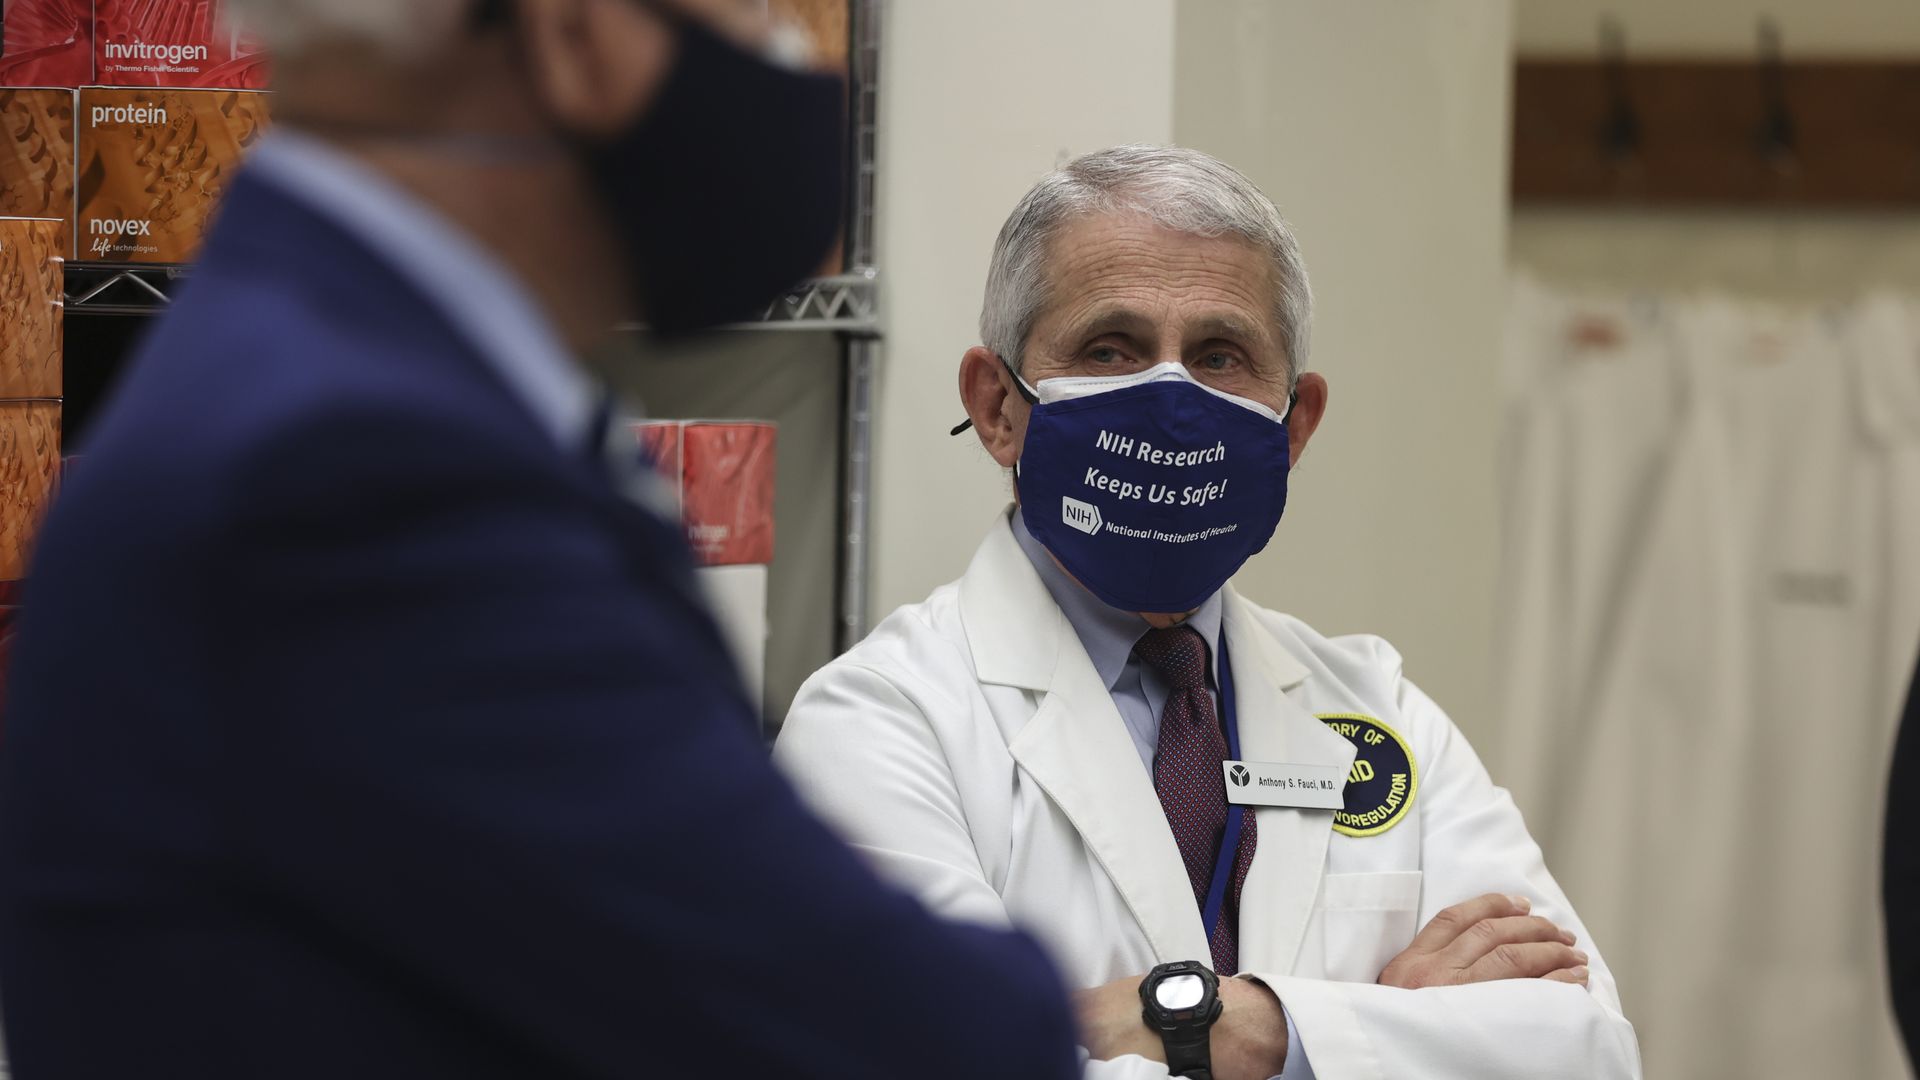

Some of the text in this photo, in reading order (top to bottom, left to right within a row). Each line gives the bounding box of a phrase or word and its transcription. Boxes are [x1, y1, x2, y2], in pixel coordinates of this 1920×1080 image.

[105, 40, 207, 64] invitrogen
[105, 64, 200, 73] by Thermo Fisher Scientific
[92, 103, 167, 127] protein
[90, 218, 150, 235] novex
[90, 237, 158, 257] life technologies
[1095, 429, 1226, 467] NIH Research
[1084, 466, 1228, 507] Keeps Us Safe!
[1065, 504, 1093, 526] NIH
[1105, 521, 1151, 539] National
[1152, 529, 1199, 543] Institutes
[1200, 527, 1211, 541] of
[1326, 722, 1386, 746] ORY OF
[1258, 776, 1336, 791] Anthony S. Fauci, M.D.
